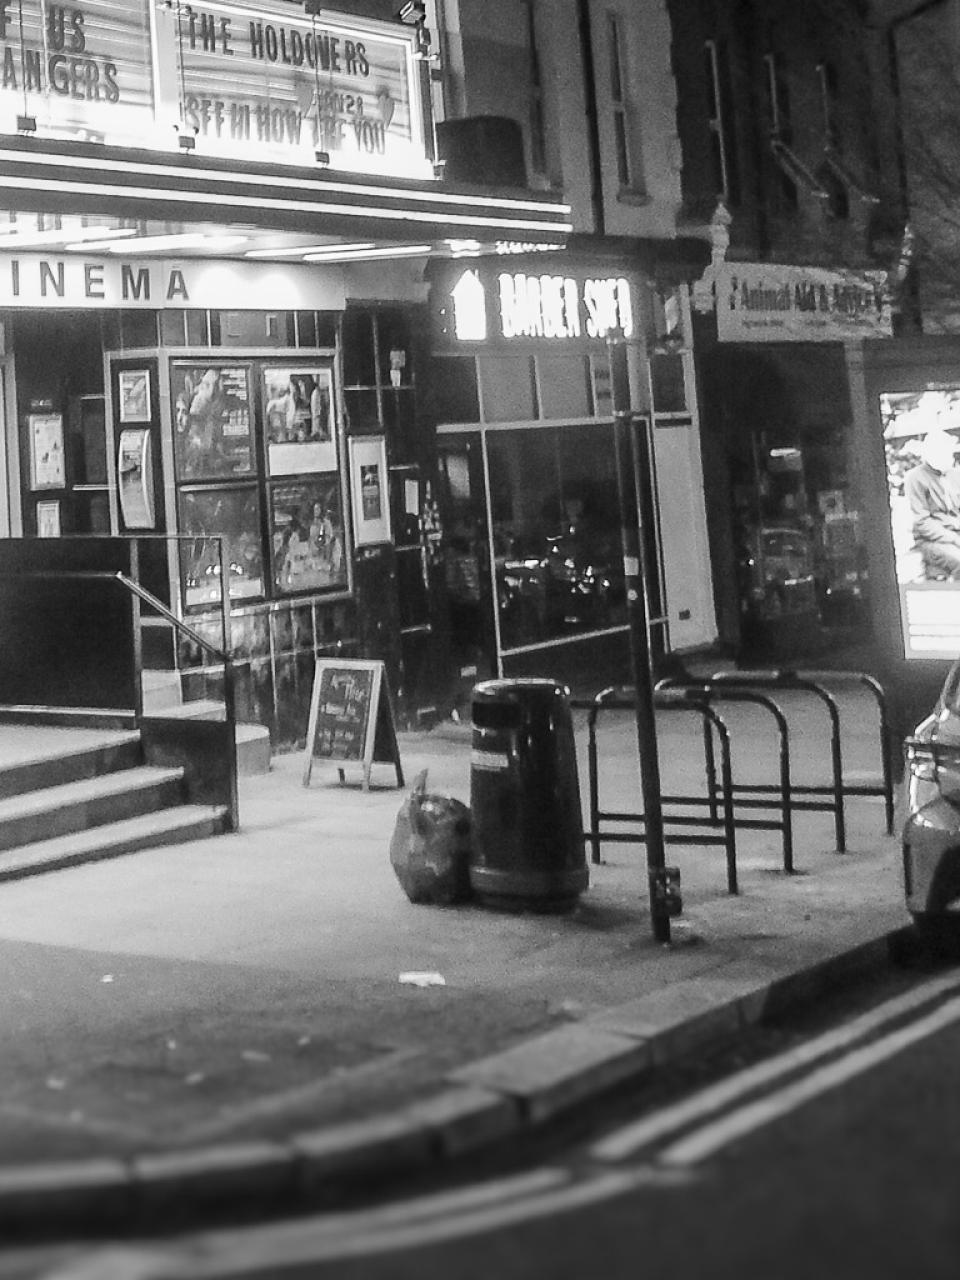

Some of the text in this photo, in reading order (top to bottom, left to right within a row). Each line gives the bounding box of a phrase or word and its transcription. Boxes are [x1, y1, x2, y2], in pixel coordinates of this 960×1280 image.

[44, 4, 86, 54] US
[188, 12, 371, 78] THE HOLDOVERS
[353, 119, 386, 155] YOU
